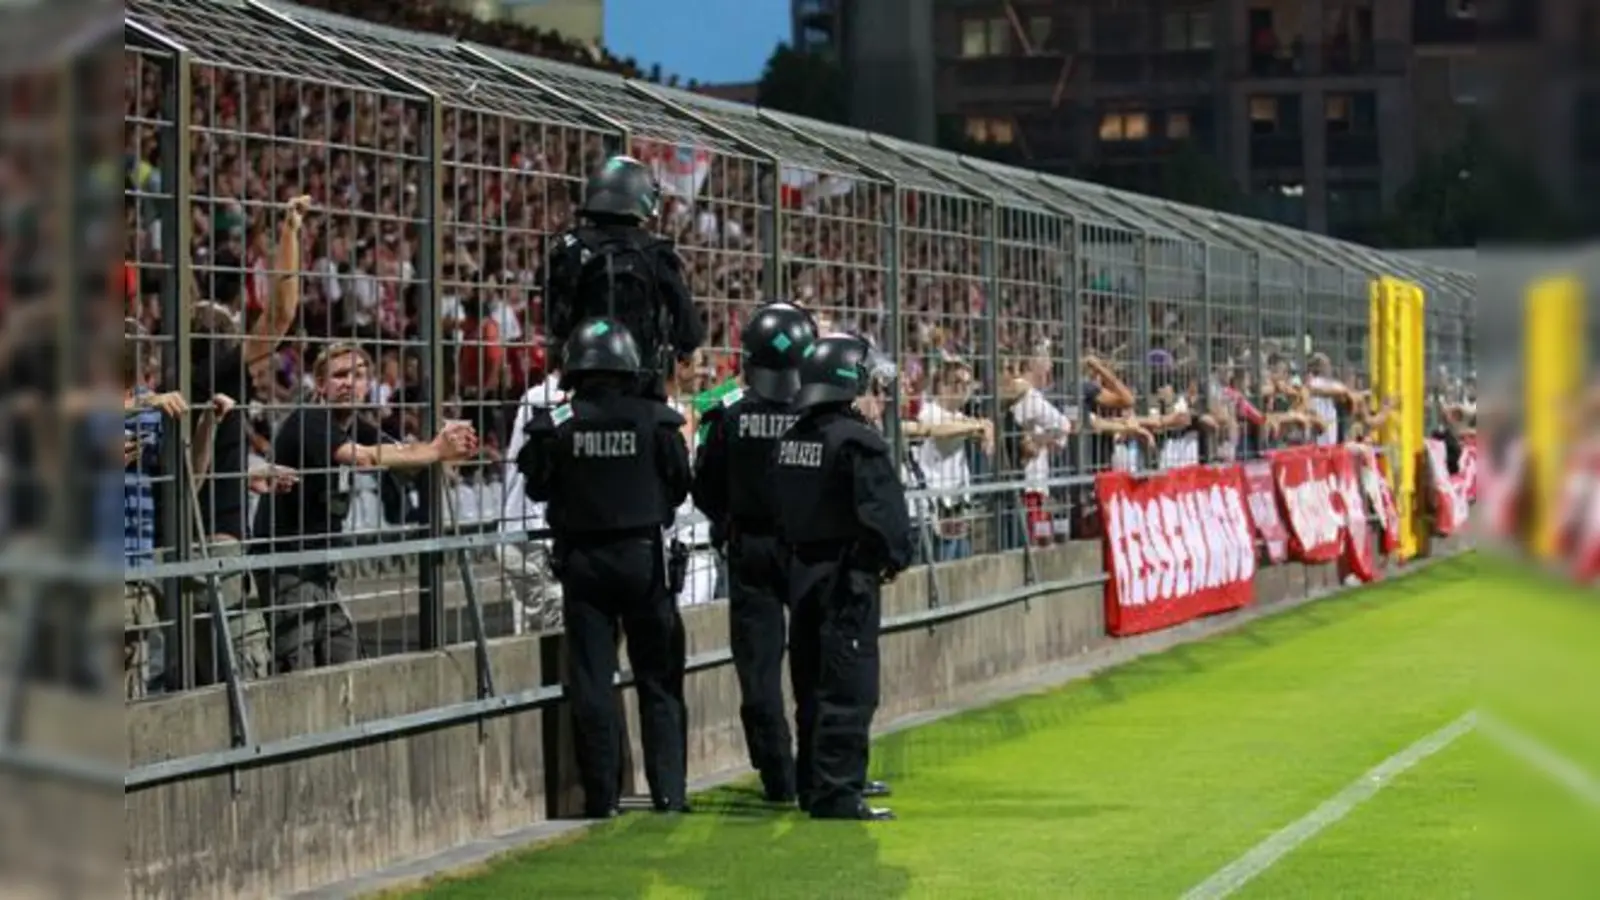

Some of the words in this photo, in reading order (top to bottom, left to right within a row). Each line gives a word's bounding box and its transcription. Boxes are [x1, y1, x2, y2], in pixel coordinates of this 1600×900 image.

[739, 414, 800, 438] POLIZE
[573, 431, 636, 457] POLIZEI
[778, 441, 823, 467] POLIZEI
